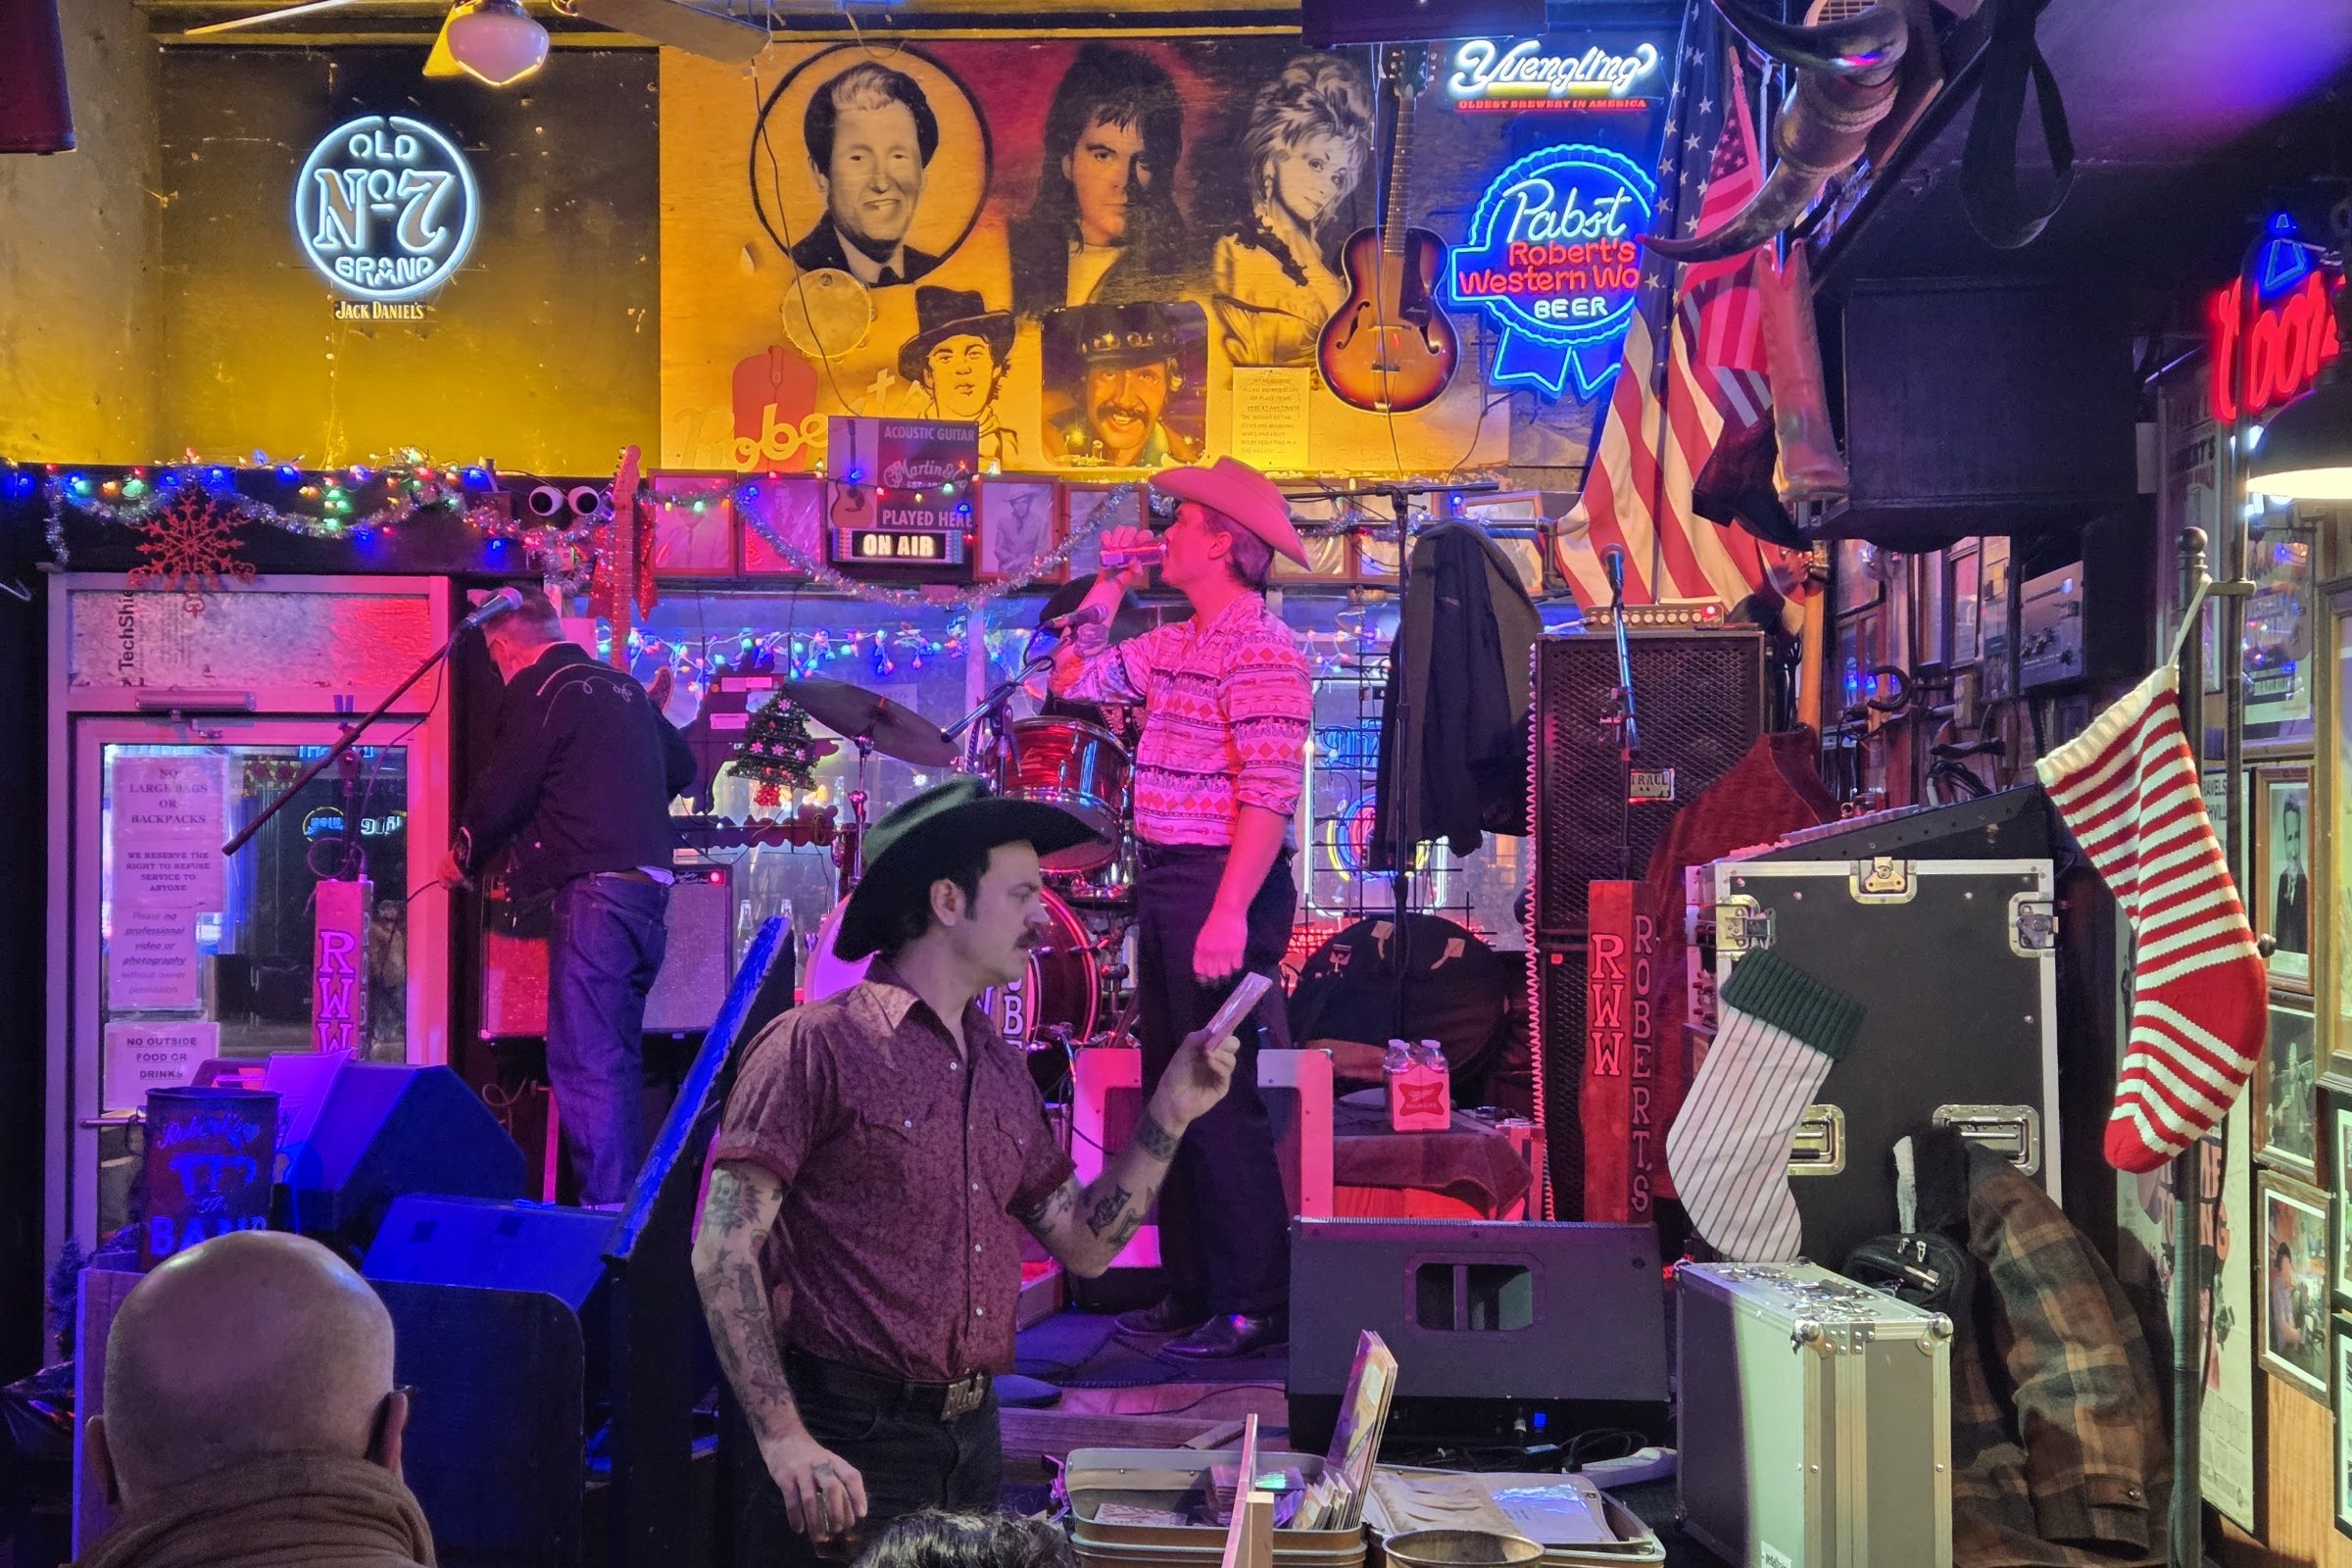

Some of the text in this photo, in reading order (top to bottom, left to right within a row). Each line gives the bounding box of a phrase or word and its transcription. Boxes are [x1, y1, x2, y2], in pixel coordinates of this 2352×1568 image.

[1450, 40, 1658, 93] Yuengling
[1458, 100, 1647, 110] OLDEST BREWERY IN AMERICA
[348, 129, 417, 160] OLD
[1502, 177, 1633, 244] Pabst
[1508, 237, 1637, 267] Robert's
[1458, 265, 1587, 295] Western
[335, 301, 425, 319] JACK DANIEL'S
[1534, 296, 1608, 319] BEER
[884, 425, 975, 442] ACOUSTIC GUITAR
[883, 509, 973, 528] PLAYED HERE
[862, 533, 935, 558] ON AIR
[159, 767, 179, 779] NO
[129, 783, 208, 794] LARGE BAGS
[159, 799, 178, 808] OR
[130, 814, 207, 824] BACKPACKS
[164, 912, 177, 921] no
[124, 927, 185, 937] professional
[134, 941, 162, 951] video
[122, 956, 187, 967] photography
[1591, 933, 1625, 1076] RWW
[126, 1037, 197, 1047] NO OUTSIDE
[135, 1053, 168, 1062] FOOD
[139, 1070, 183, 1079] DRINKS
